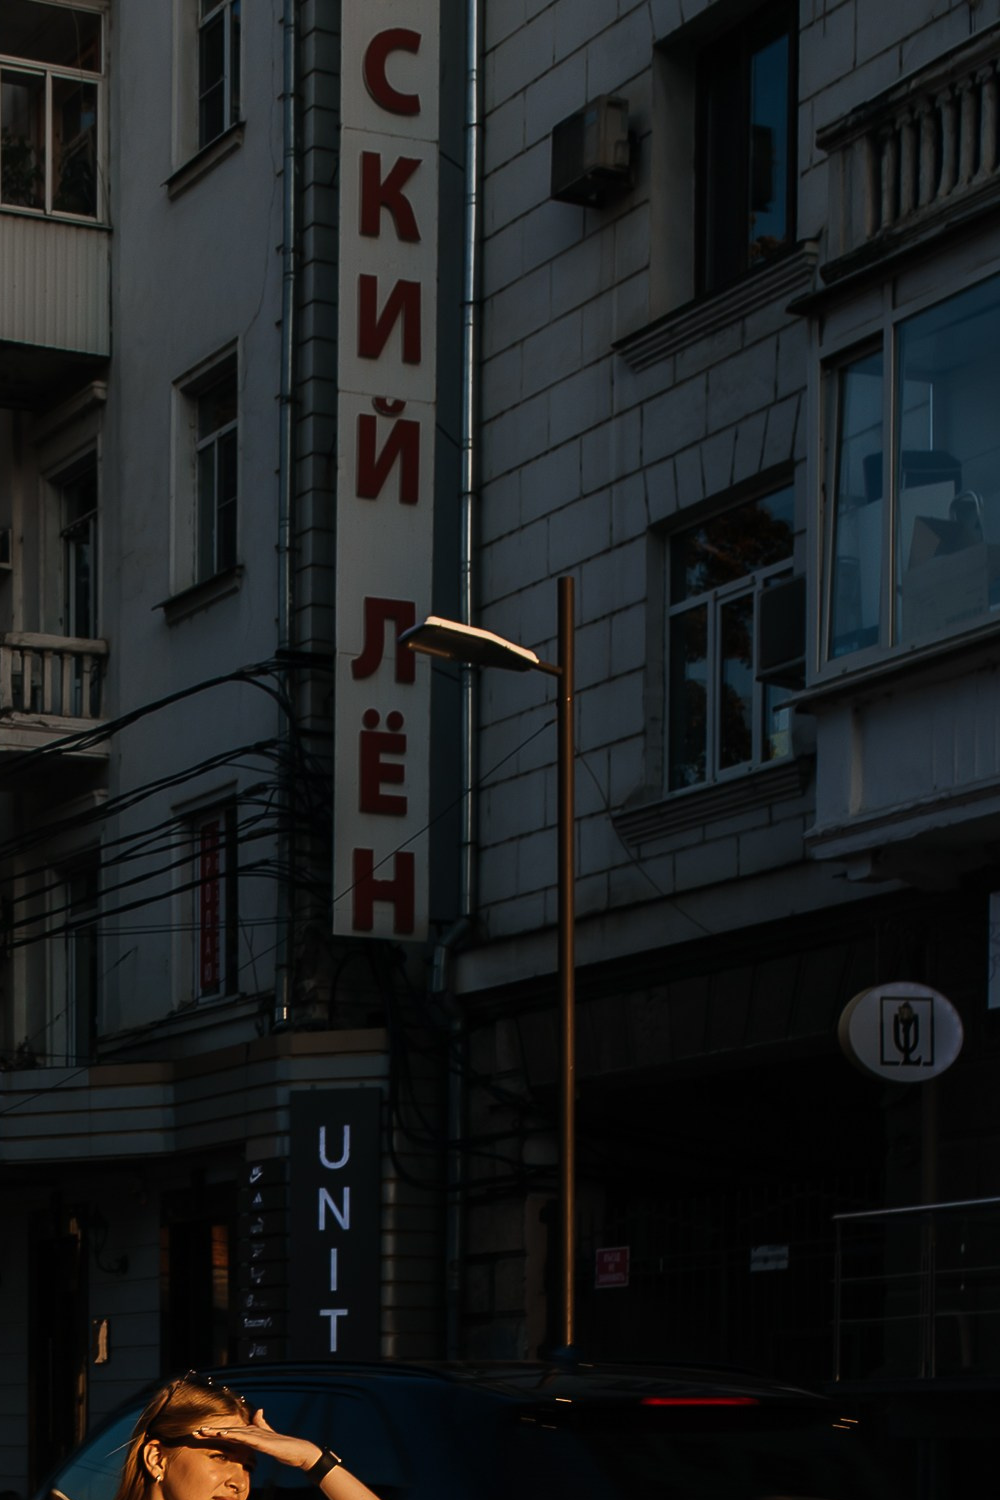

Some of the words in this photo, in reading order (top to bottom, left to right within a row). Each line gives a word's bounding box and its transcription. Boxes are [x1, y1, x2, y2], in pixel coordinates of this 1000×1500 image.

[355, 27, 422, 506] СКИЙ
[351, 596, 416, 934] ЛЁН
[318, 1124, 351, 1353] UNIT
